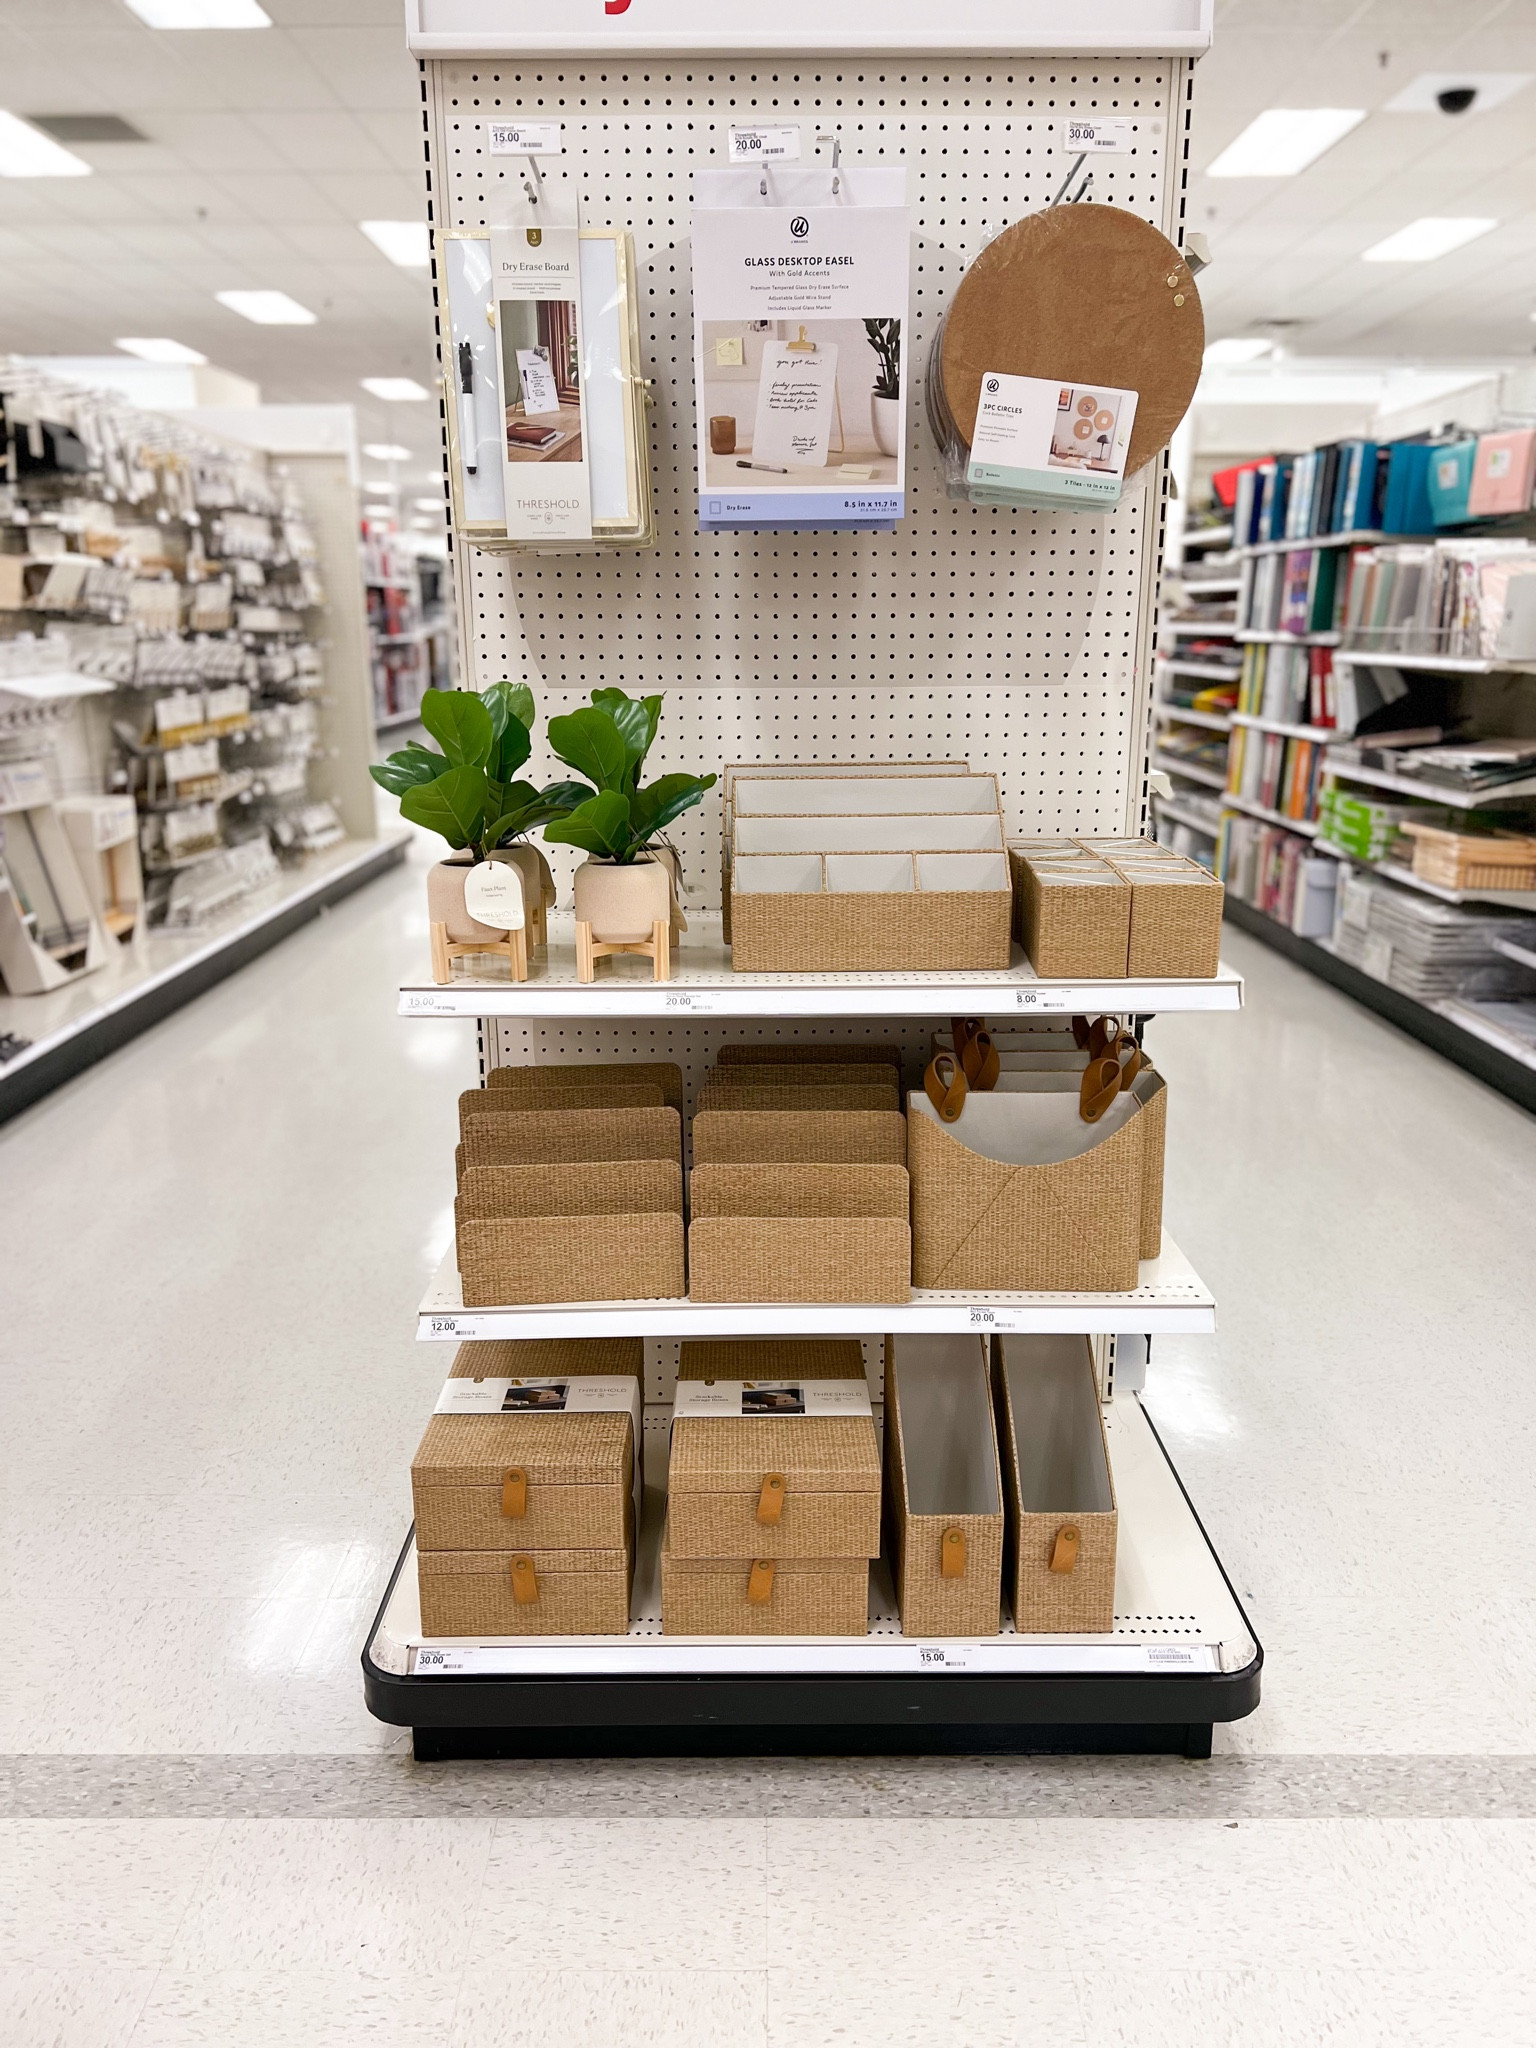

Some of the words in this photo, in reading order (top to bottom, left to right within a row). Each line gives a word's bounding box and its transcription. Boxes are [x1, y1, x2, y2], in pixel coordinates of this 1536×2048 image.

[493, 133, 519, 142] 15.00
[1069, 129, 1094, 139] 30.00
[736, 139, 762, 150] 20.00
[532, 232, 537, 240] 3
[745, 258, 775, 266] GLASS
[778, 257, 823, 266] DESKTOP
[826, 256, 854, 265] EASEL
[502, 262, 517, 272] Dry
[520, 263, 542, 271] Erase
[545, 262, 569, 271] Board
[997, 405, 1022, 414] CIRCLES
[517, 500, 579, 509] THRESHOLD
[844, 500, 856, 508] 8.5
[410, 998, 434, 1006] 15.00
[1017, 995, 1036, 1003] 8.00
[970, 1313, 994, 1322] 20.00
[431, 1322, 455, 1331] 12.00
[419, 1656, 444, 1664] 30.00
[921, 1653, 945, 1662] 15.00
